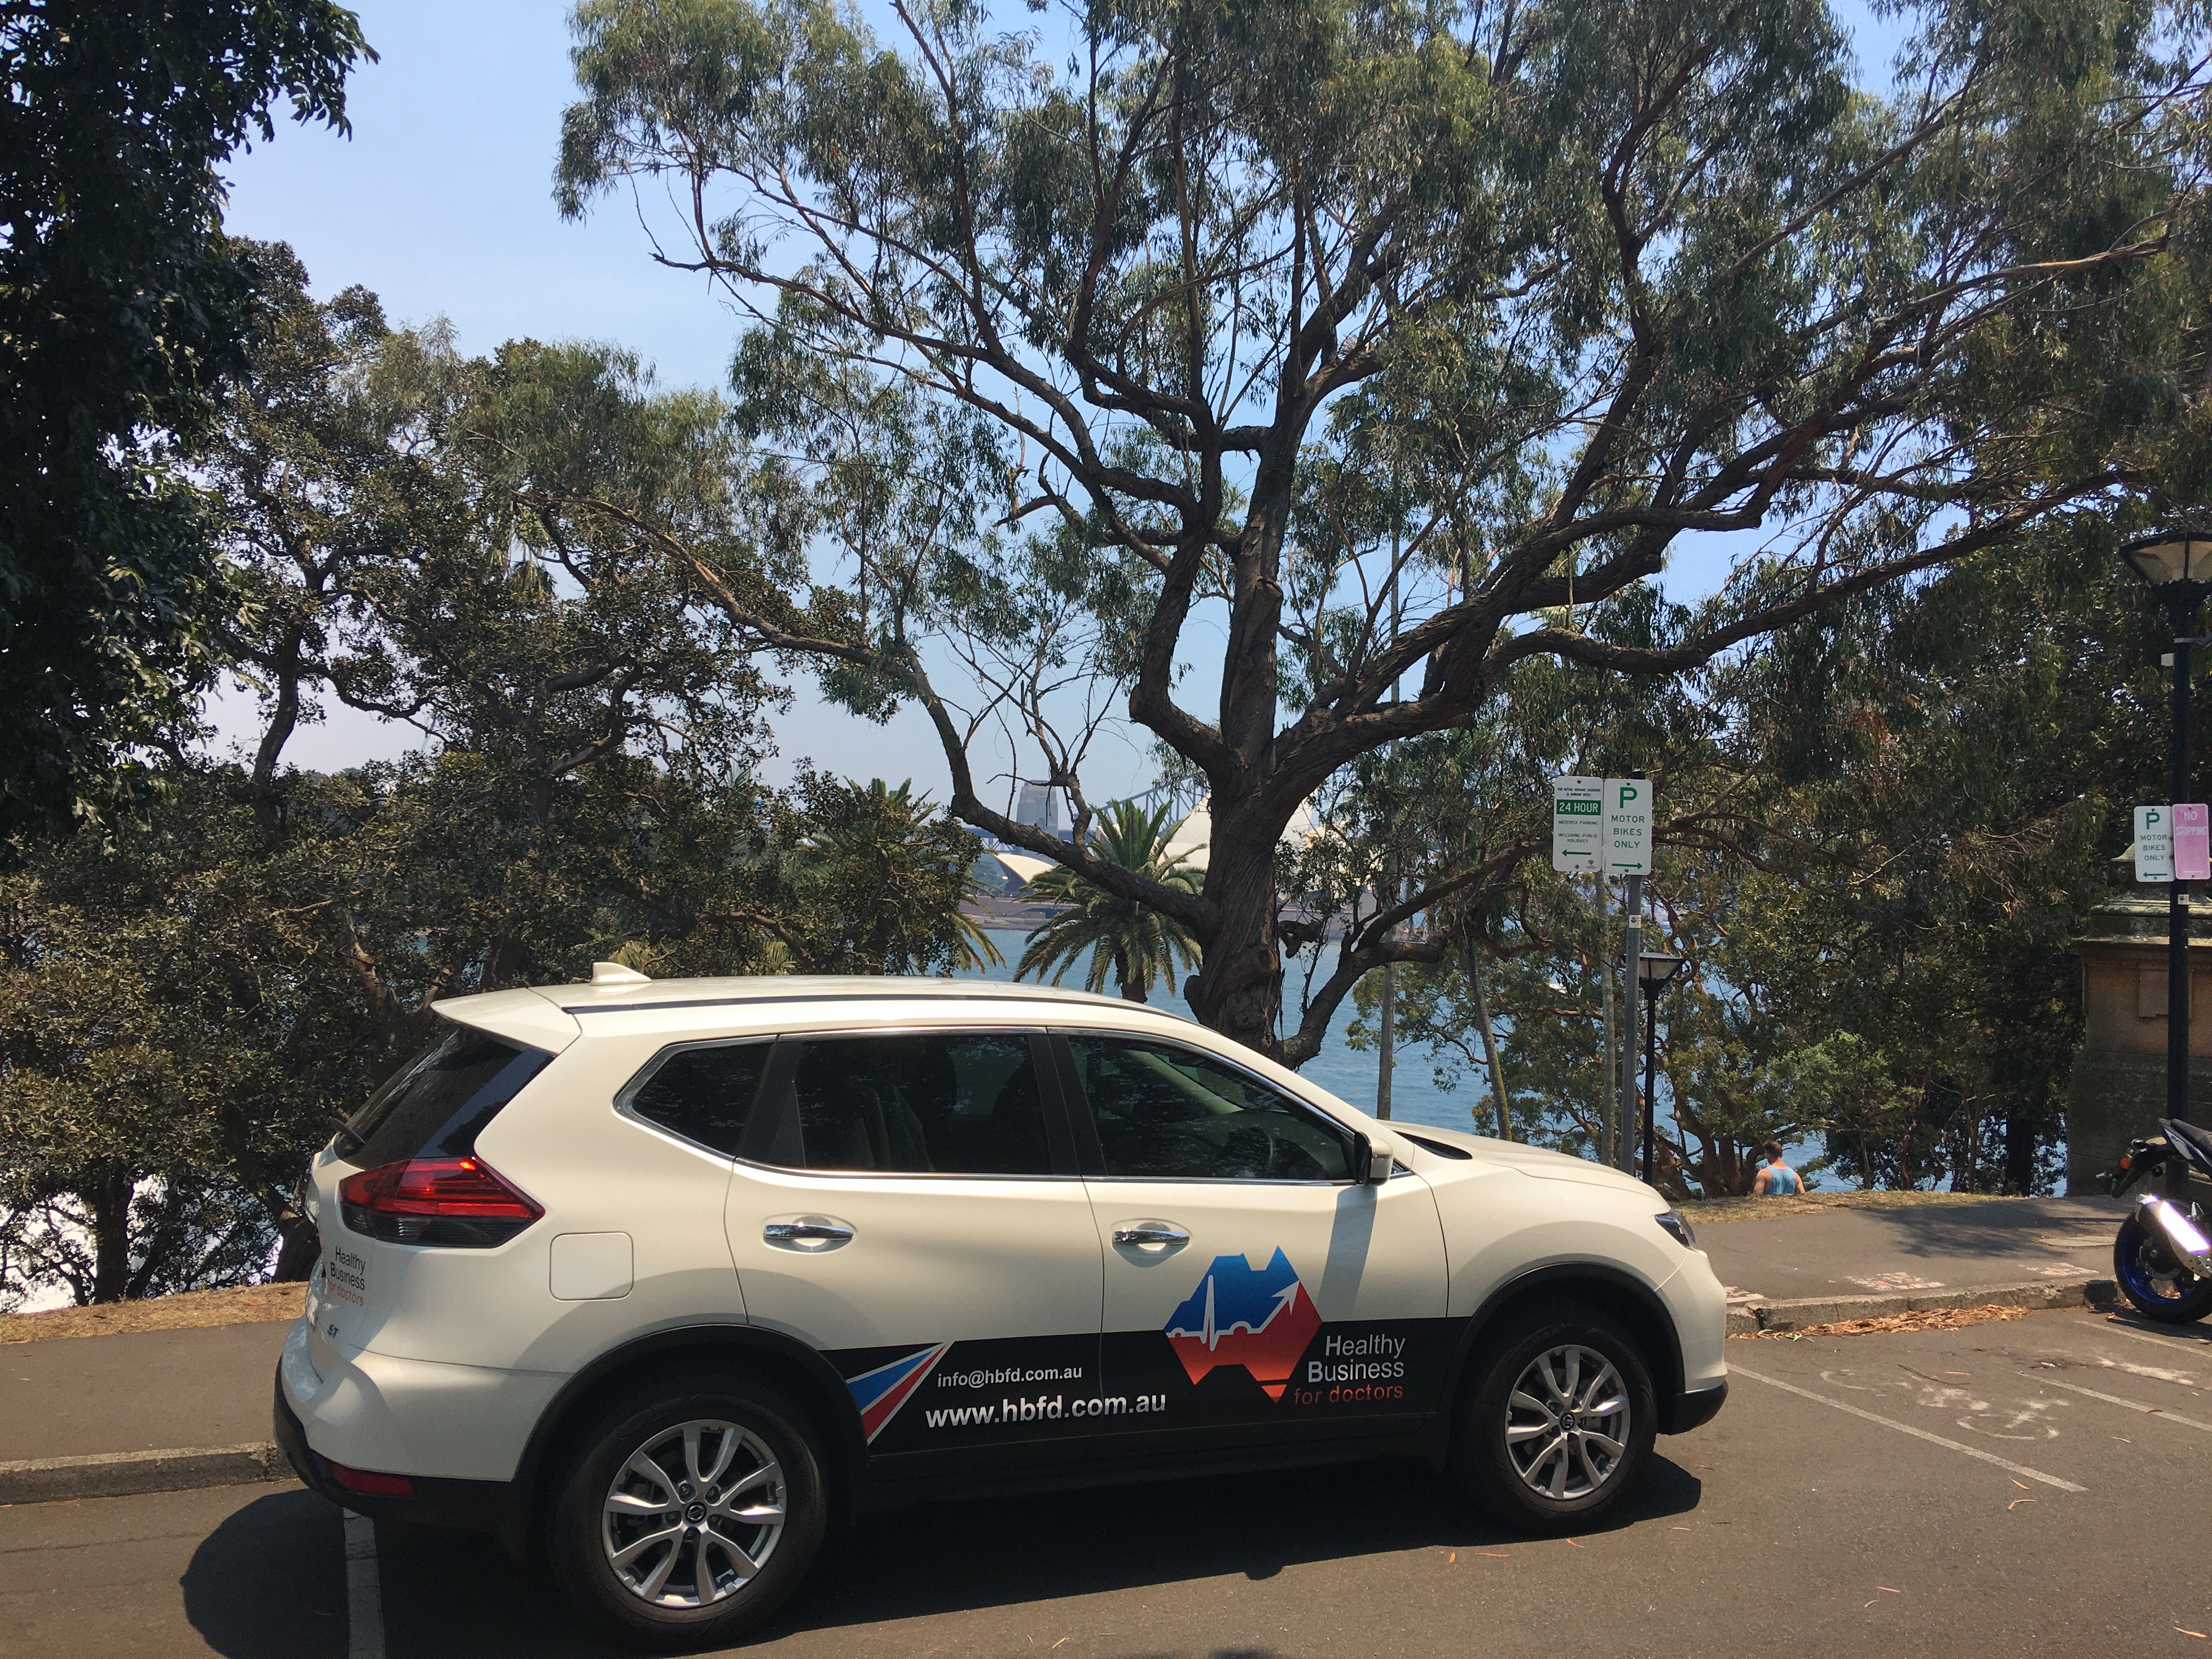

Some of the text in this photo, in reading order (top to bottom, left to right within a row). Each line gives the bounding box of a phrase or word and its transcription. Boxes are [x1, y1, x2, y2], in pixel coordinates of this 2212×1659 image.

[1559, 803, 1598, 812] 24 HOUR
[1620, 787, 1638, 809] P
[2146, 812, 2160, 830] P
[2183, 811, 2197, 821] NO
[1613, 828, 1642, 836] BIKES
[2175, 826, 2207, 836] STOPPING
[1614, 840, 1640, 848] ONLY
[335, 1245, 366, 1275] Healthy
[330, 1261, 365, 1291] Business
[337, 1284, 364, 1307] doctors
[327, 1324, 339, 1339] ST
[1325, 1333, 1406, 1359] Healthy
[937, 1366, 1082, 1388] info@hbfd.com.au
[1308, 1358, 1404, 1383] Business
[1294, 1384, 1403, 1405] for doctors
[925, 1393, 1166, 1428] www.hbfd.com.au
